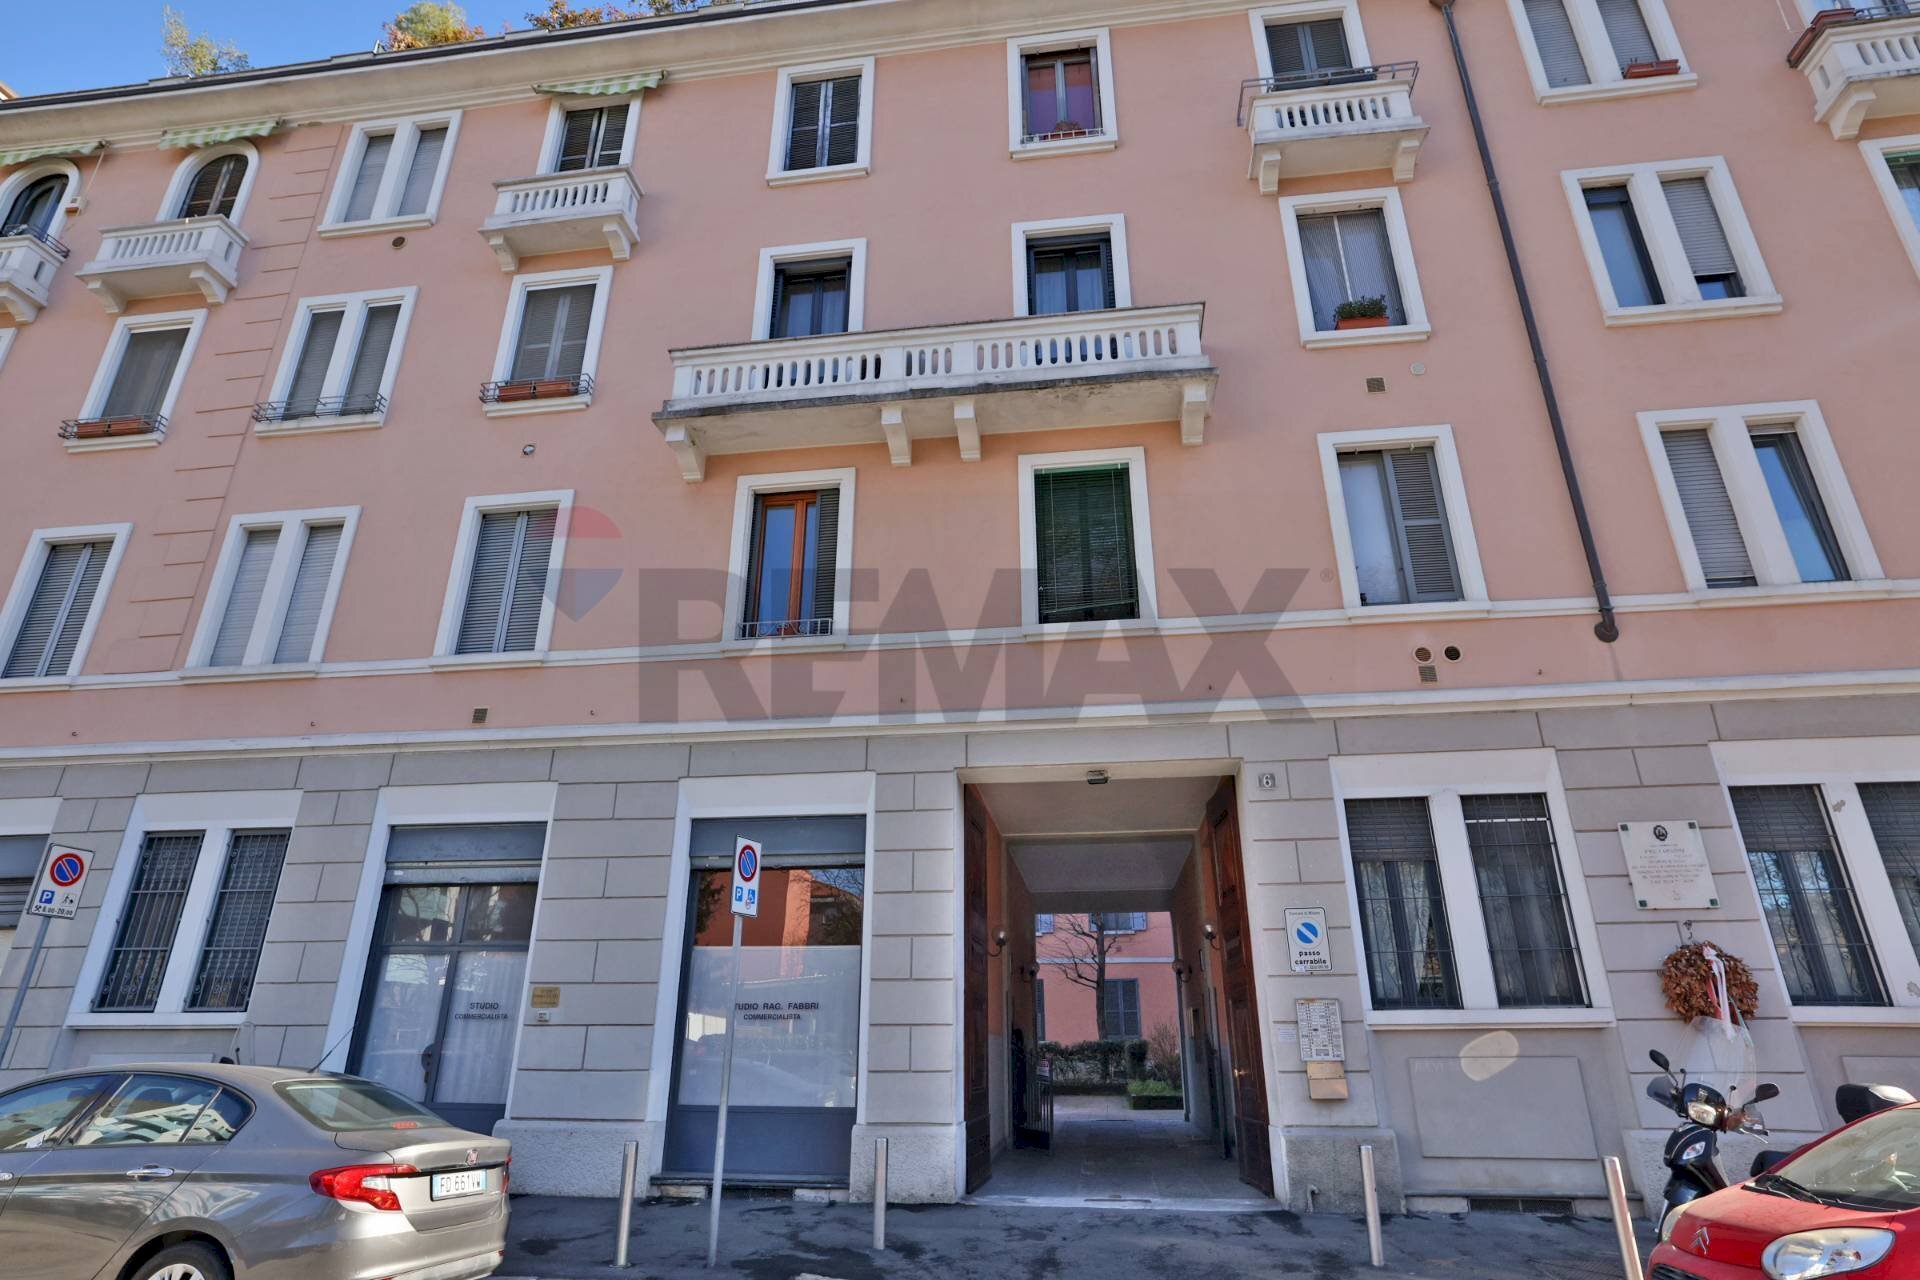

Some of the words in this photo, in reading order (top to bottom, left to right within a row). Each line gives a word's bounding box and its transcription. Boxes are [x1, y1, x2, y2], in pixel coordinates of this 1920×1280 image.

[1264, 775, 1272, 788] 6
[42, 892, 52, 903] P
[736, 888, 742, 900] P
[470, 1002, 499, 1010] STUDIO
[735, 1002, 759, 1010] TUDIO
[788, 1002, 819, 1010] FABBRI
[743, 1013, 801, 1021] COMMERCIALISTA
